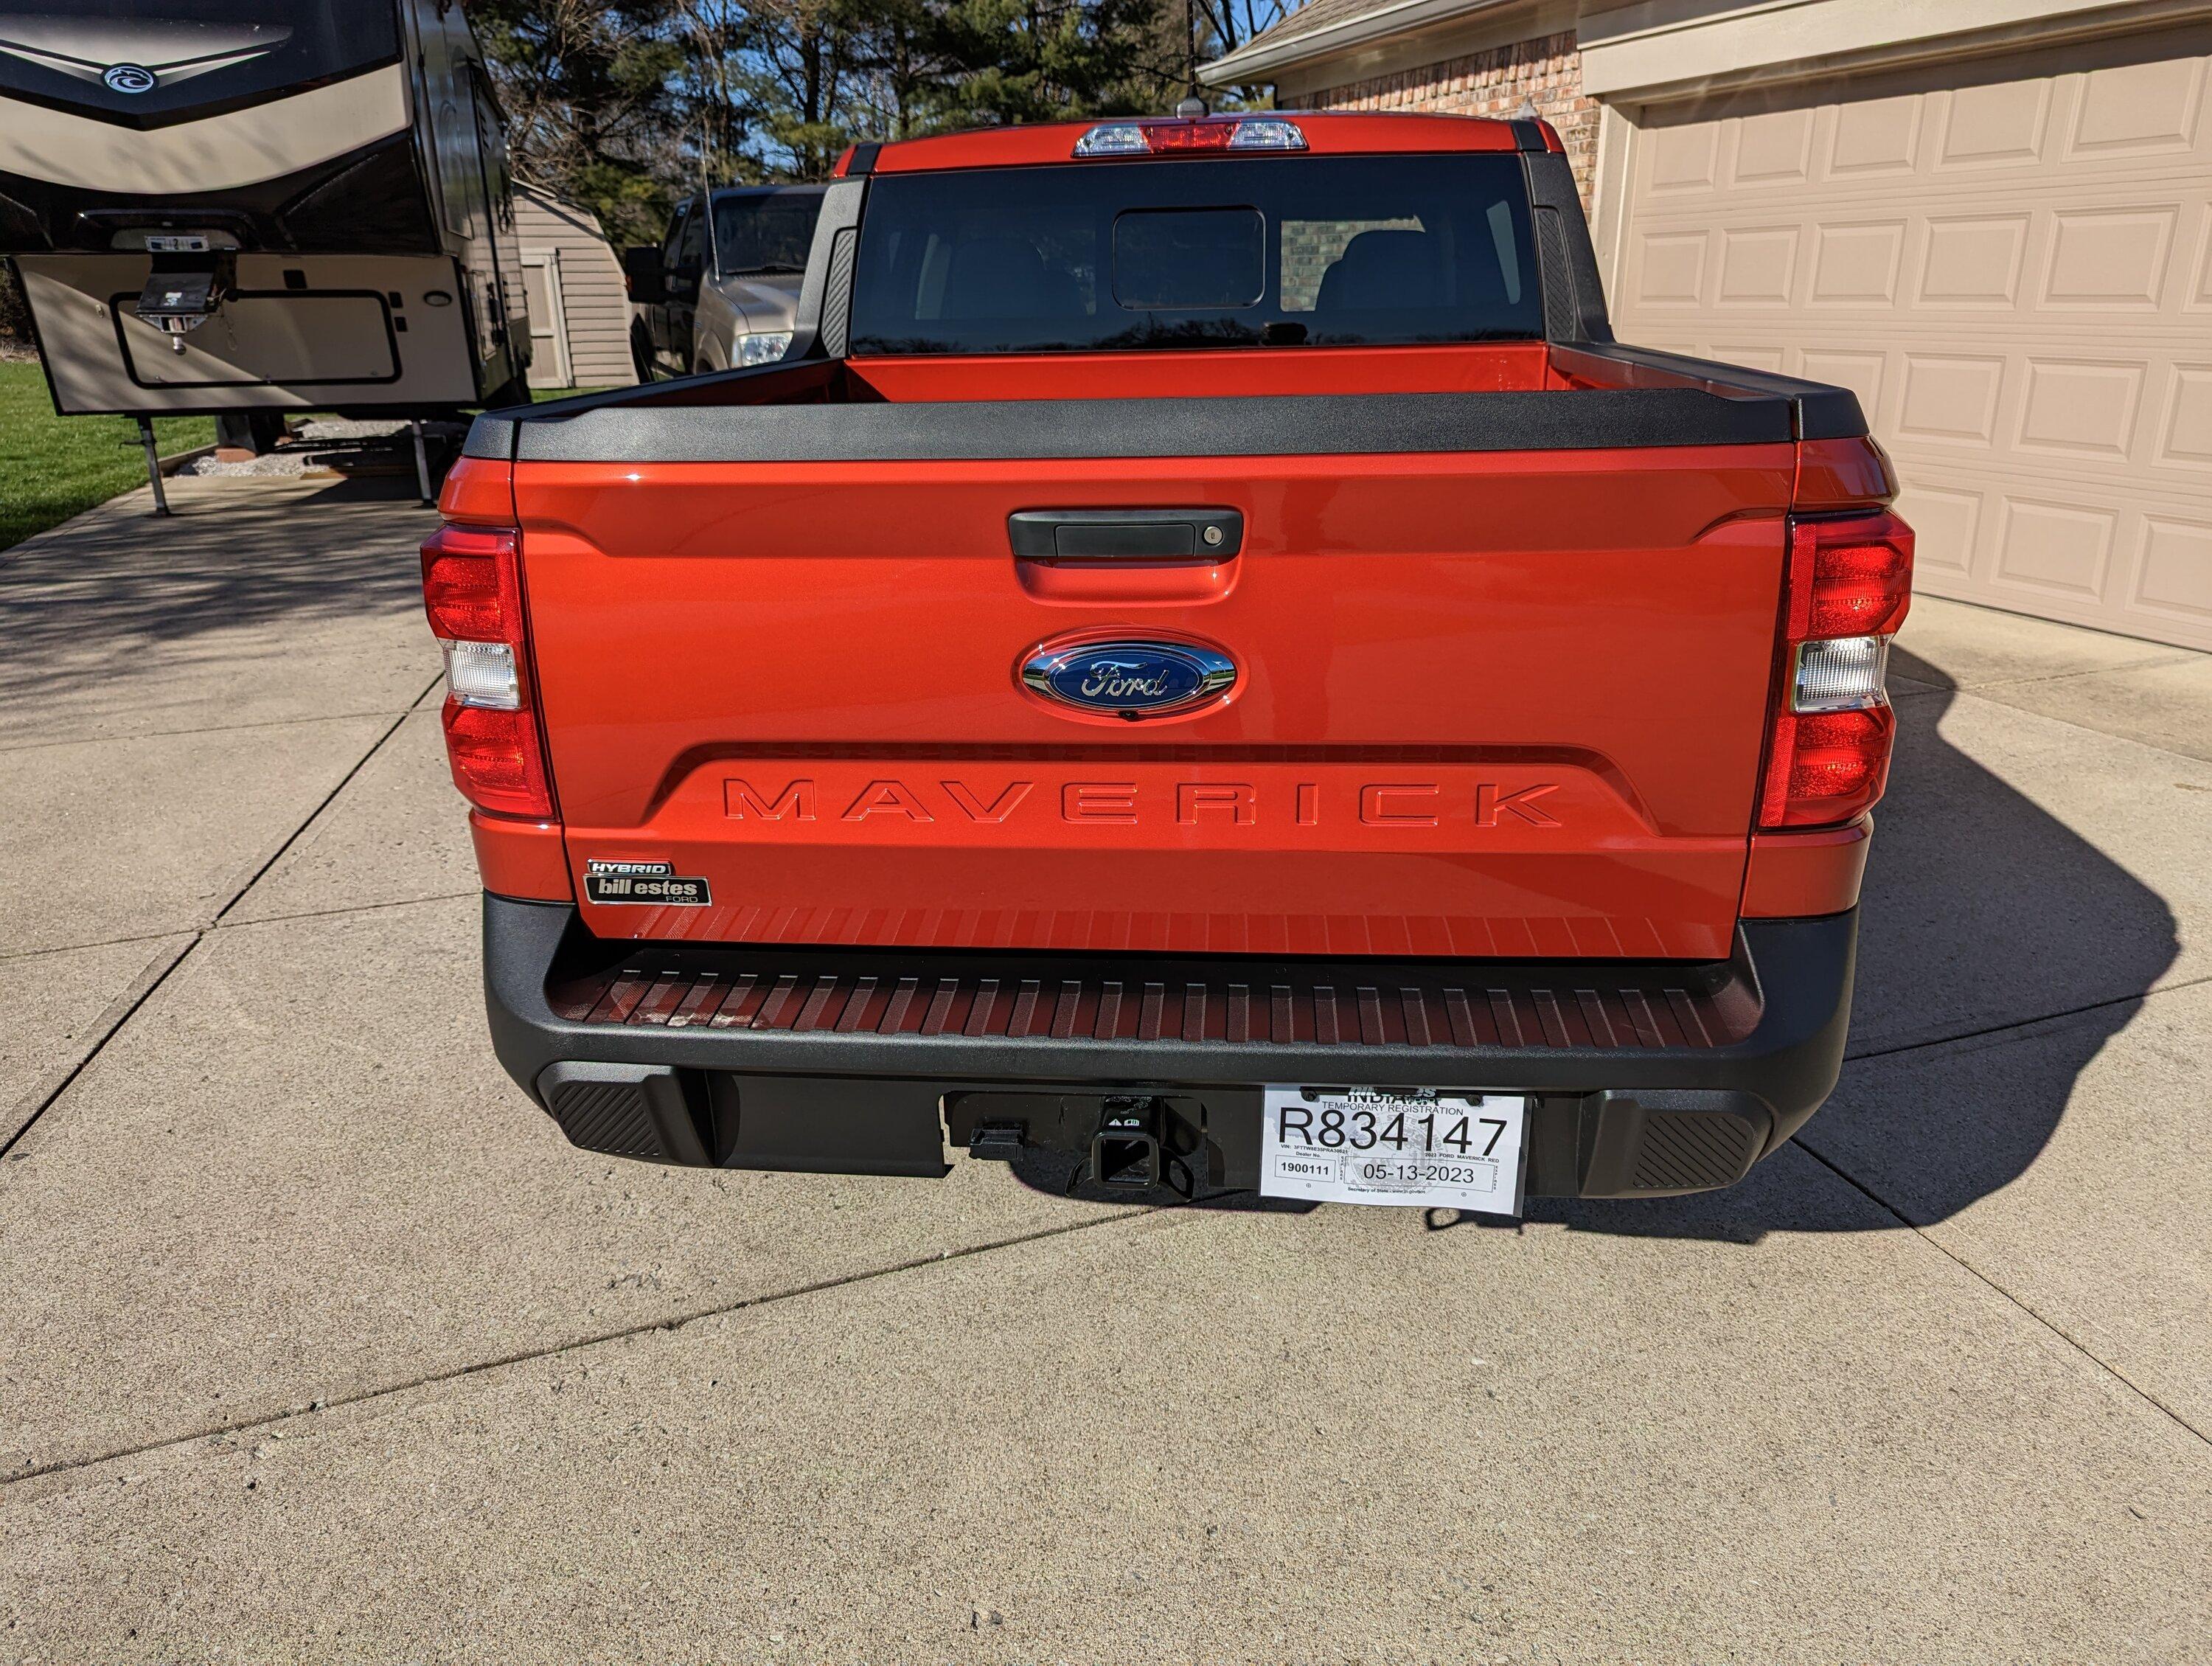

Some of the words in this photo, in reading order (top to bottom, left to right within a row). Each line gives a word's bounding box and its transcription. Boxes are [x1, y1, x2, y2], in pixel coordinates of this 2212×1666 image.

[1081, 660, 1168, 696] Ford
[723, 778, 1562, 826] MAVERICK
[592, 863, 667, 874] HYBRID
[598, 878, 632, 895] bill
[634, 880, 698, 895] estes
[1322, 1101, 1385, 1112] TEMPORARY
[1388, 1104, 1464, 1116] REGISTRATION
[1279, 1107, 1508, 1156] R834147
[1281, 1162, 1329, 1176] 1900111
[1363, 1164, 1475, 1184] 05-13-2023
